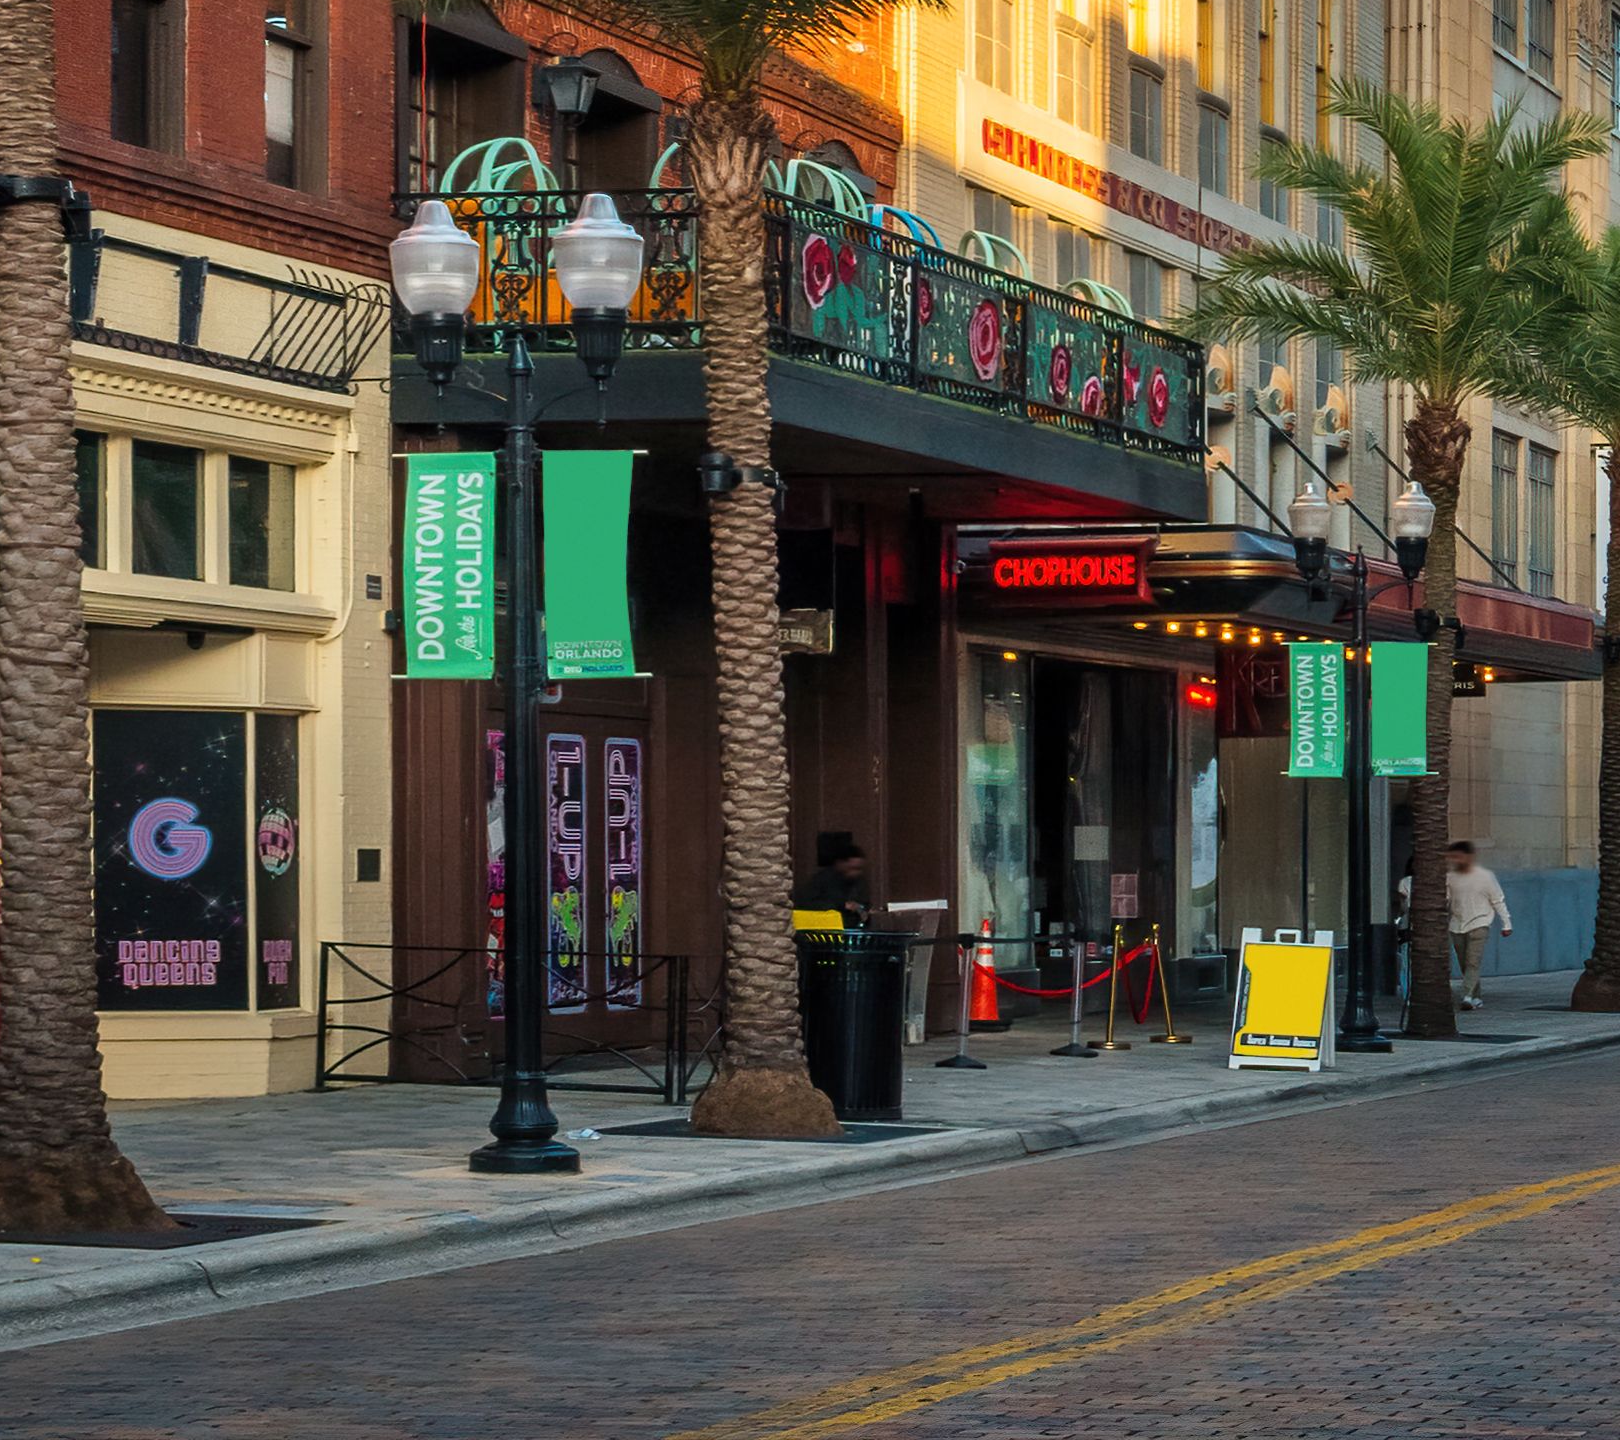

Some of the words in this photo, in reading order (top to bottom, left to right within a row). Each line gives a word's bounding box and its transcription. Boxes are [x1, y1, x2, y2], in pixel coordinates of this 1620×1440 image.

[414, 473, 447, 661] DOWNTOWN
[454, 471, 484, 610] HOLIDAYS
[993, 555, 1136, 588] CHOPHOUSE
[555, 648, 623, 660] ORLANDO
[1320, 653, 1338, 737] HOLIDAYS
[1296, 654, 1315, 768] DOWNTOWN
[128, 797, 213, 880] G
